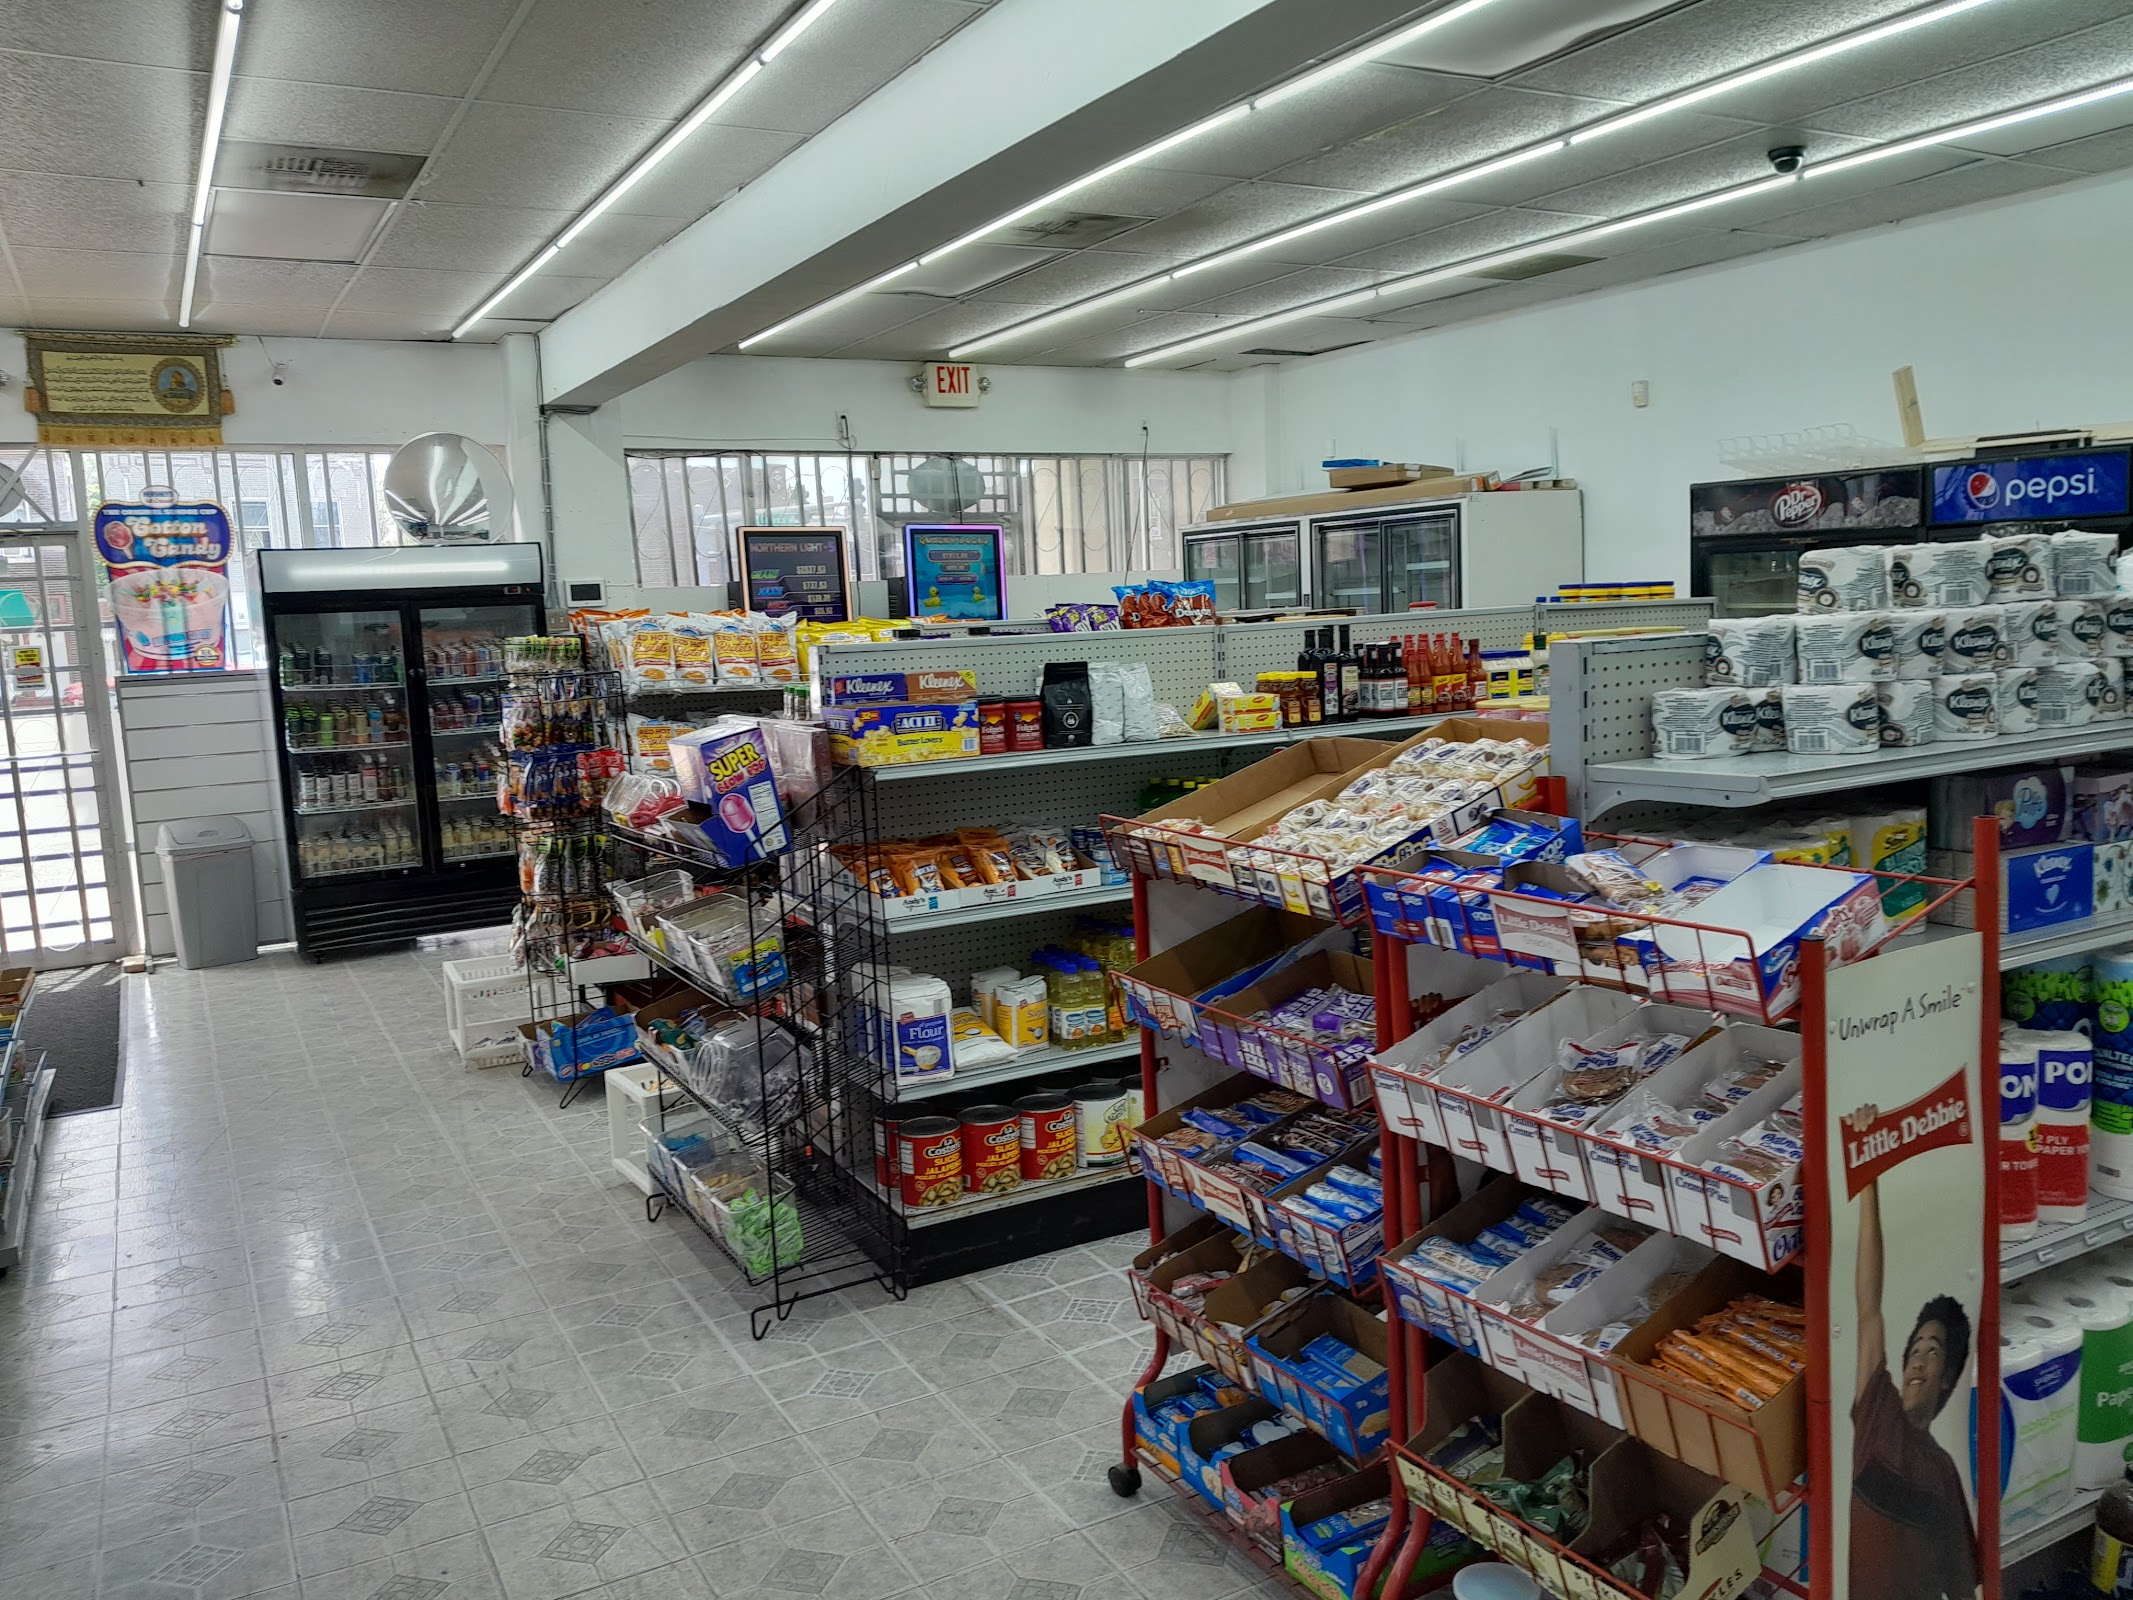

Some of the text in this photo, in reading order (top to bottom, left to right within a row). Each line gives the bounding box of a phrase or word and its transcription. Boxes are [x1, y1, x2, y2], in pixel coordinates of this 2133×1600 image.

[936, 366, 970, 393] EXIT
[1789, 490, 1807, 508] Dr
[2005, 468, 2096, 507] pepsi
[1776, 495, 1822, 521] Pepper
[125, 516, 207, 537] Cotton
[143, 537, 221, 560] Candy
[750, 542, 798, 553] NORTHERN
[845, 678, 894, 696] Kleenex
[918, 673, 965, 690] Kleenex
[900, 716, 922, 729] ACT
[709, 742, 761, 782] SUPER
[716, 758, 767, 794] BLOW POP
[1499, 912, 1570, 936] Little Debbie
[1838, 984, 1962, 1041] Unwrap A Smile
[908, 1026, 944, 1041] Flour
[1848, 1097, 1967, 1169] Little Debbie
[2047, 1136, 2069, 1145] PLY
[2036, 1144, 2074, 1155] PAPER
[1515, 1339, 1585, 1380] Little Debbie
